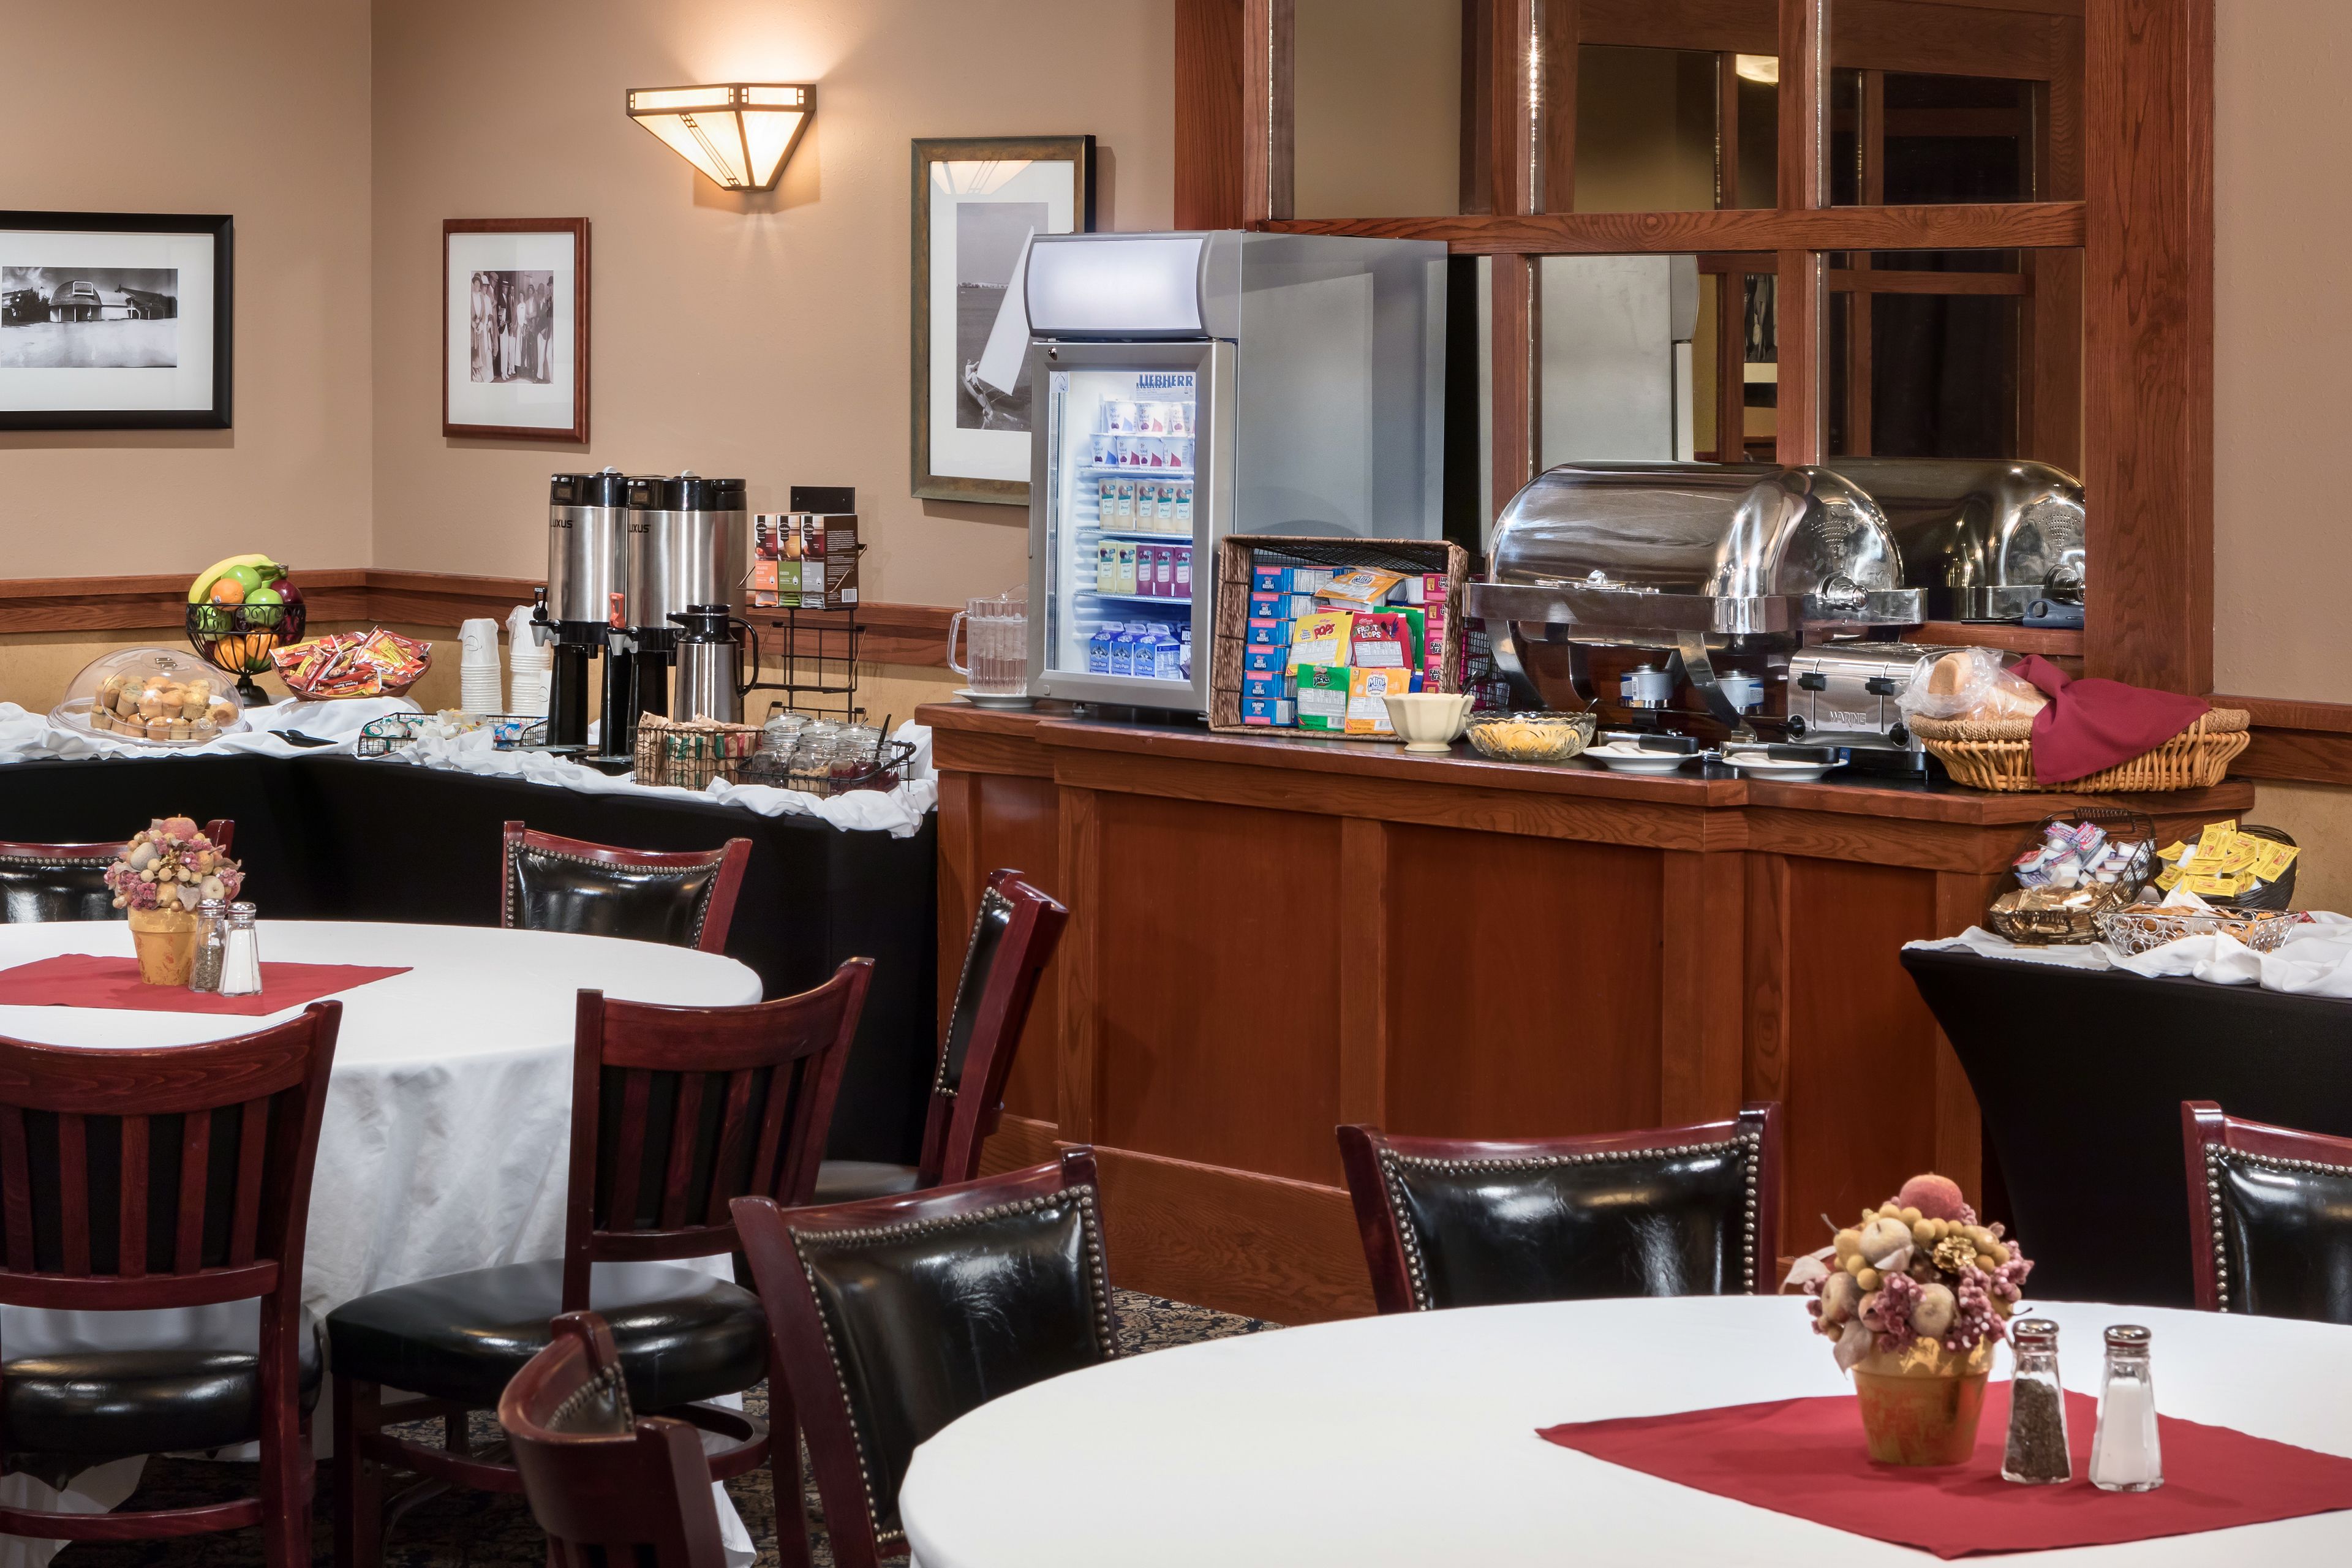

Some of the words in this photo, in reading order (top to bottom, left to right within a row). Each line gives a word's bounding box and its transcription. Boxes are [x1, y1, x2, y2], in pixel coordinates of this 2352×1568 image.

[1139, 374, 1193, 386] LIEBHERR
[1314, 624, 1335, 639] POPS
[1313, 677, 1330, 687] JACKS
[1830, 711, 1866, 728] WARING
